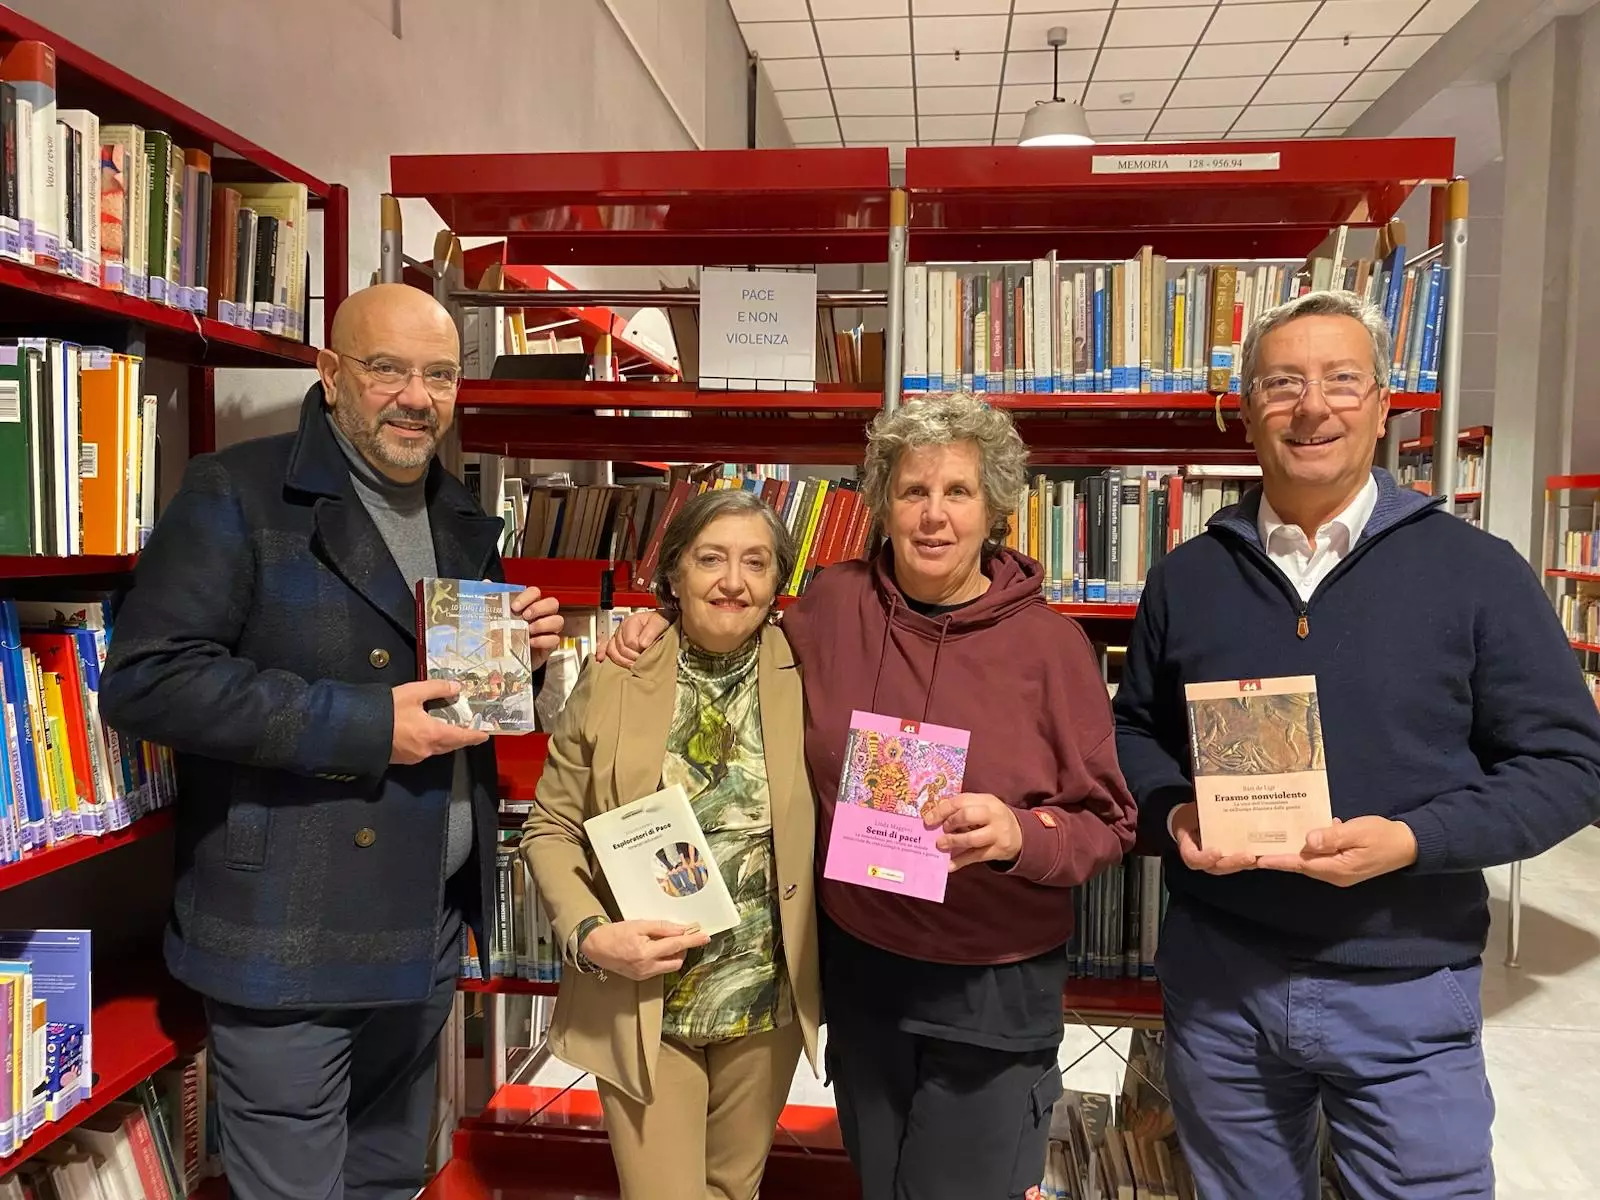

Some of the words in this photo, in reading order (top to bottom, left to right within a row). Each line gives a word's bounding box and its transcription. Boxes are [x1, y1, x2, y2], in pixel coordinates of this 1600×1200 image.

[46, 135, 54, 162] revoir
[1118, 160, 1169, 169] MEMORIA
[1188, 159, 1204, 168] 128
[1212, 159, 1243, 168] 956.94
[46, 162, 54, 188] Vous
[742, 289, 775, 301] PACE
[738, 311, 745, 322] E
[748, 312, 778, 323] NON
[726, 333, 789, 345] VIOLENZA
[1111, 485, 1118, 496] Ho
[1243, 682, 1256, 691] 44
[904, 725, 915, 734] 41
[1214, 793, 1249, 802] Erasmo
[1251, 790, 1307, 800] nonviolento
[612, 832, 649, 850] Esploratori
[648, 828, 656, 837] di
[656, 823, 672, 833] Pace
[866, 825, 887, 837] Semi
[888, 829, 897, 838] di
[898, 832, 922, 844] pace!
